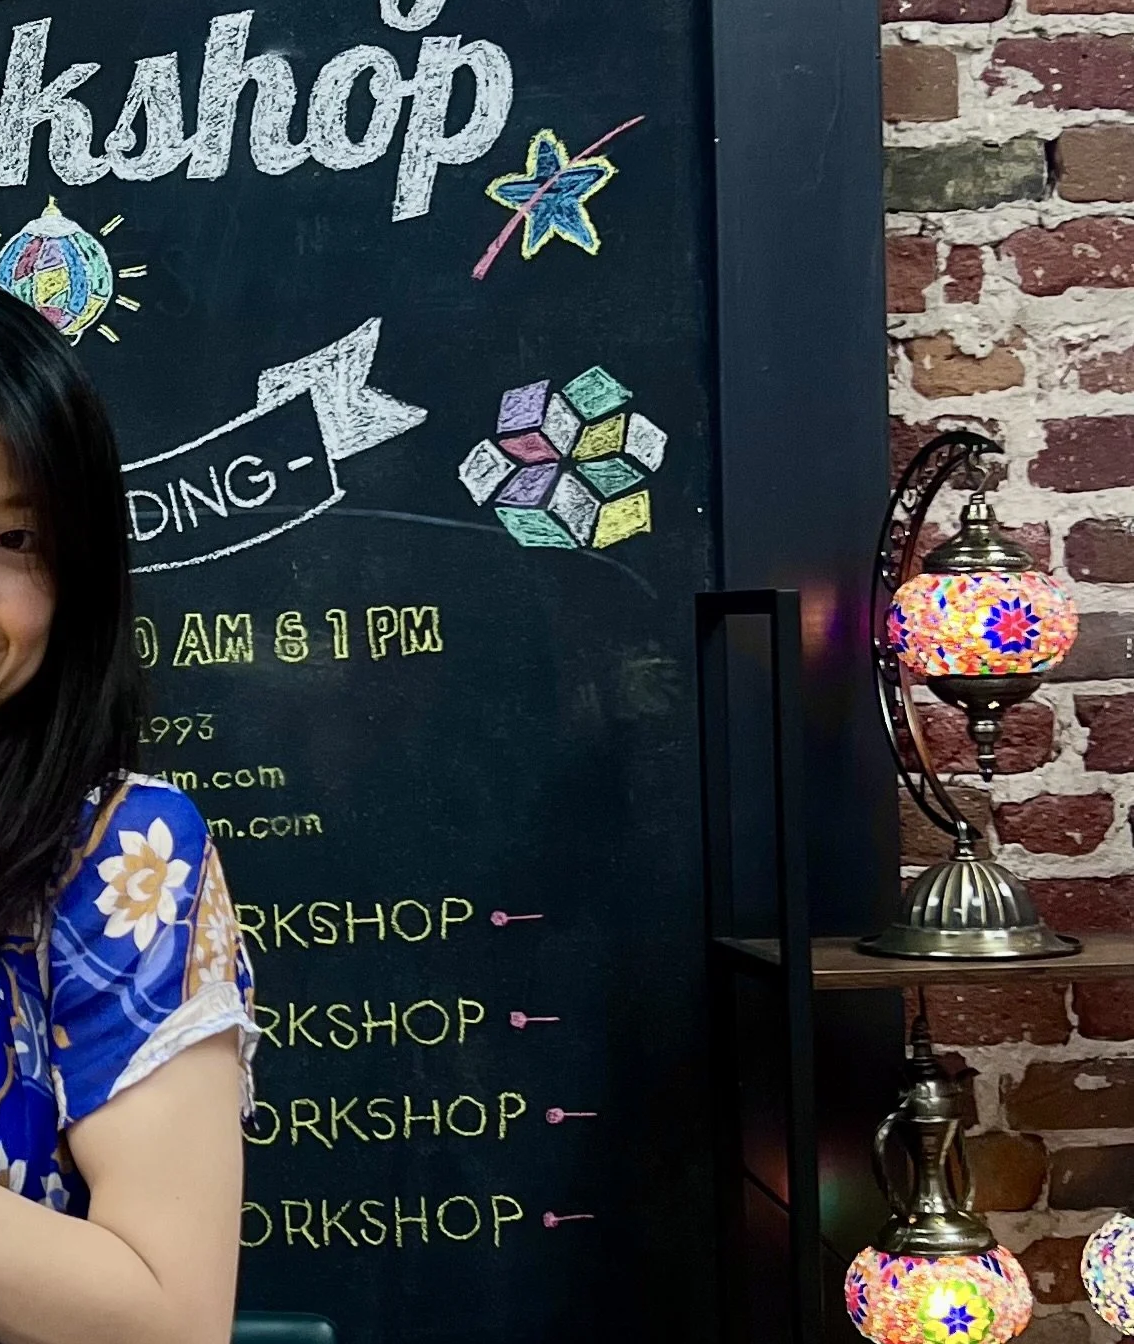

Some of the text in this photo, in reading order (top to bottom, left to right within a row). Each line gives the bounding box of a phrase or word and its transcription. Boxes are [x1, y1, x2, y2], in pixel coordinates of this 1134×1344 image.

[172, 613, 254, 668] AM
[327, 610, 349, 660] 1
[366, 606, 443, 661] PM
[235, 897, 474, 953] RKSHOP
[254, 997, 486, 1050] RKSHOP
[241, 1091, 527, 1149] ORKSHOP
[239, 1194, 524, 1248] ORKSHOP
